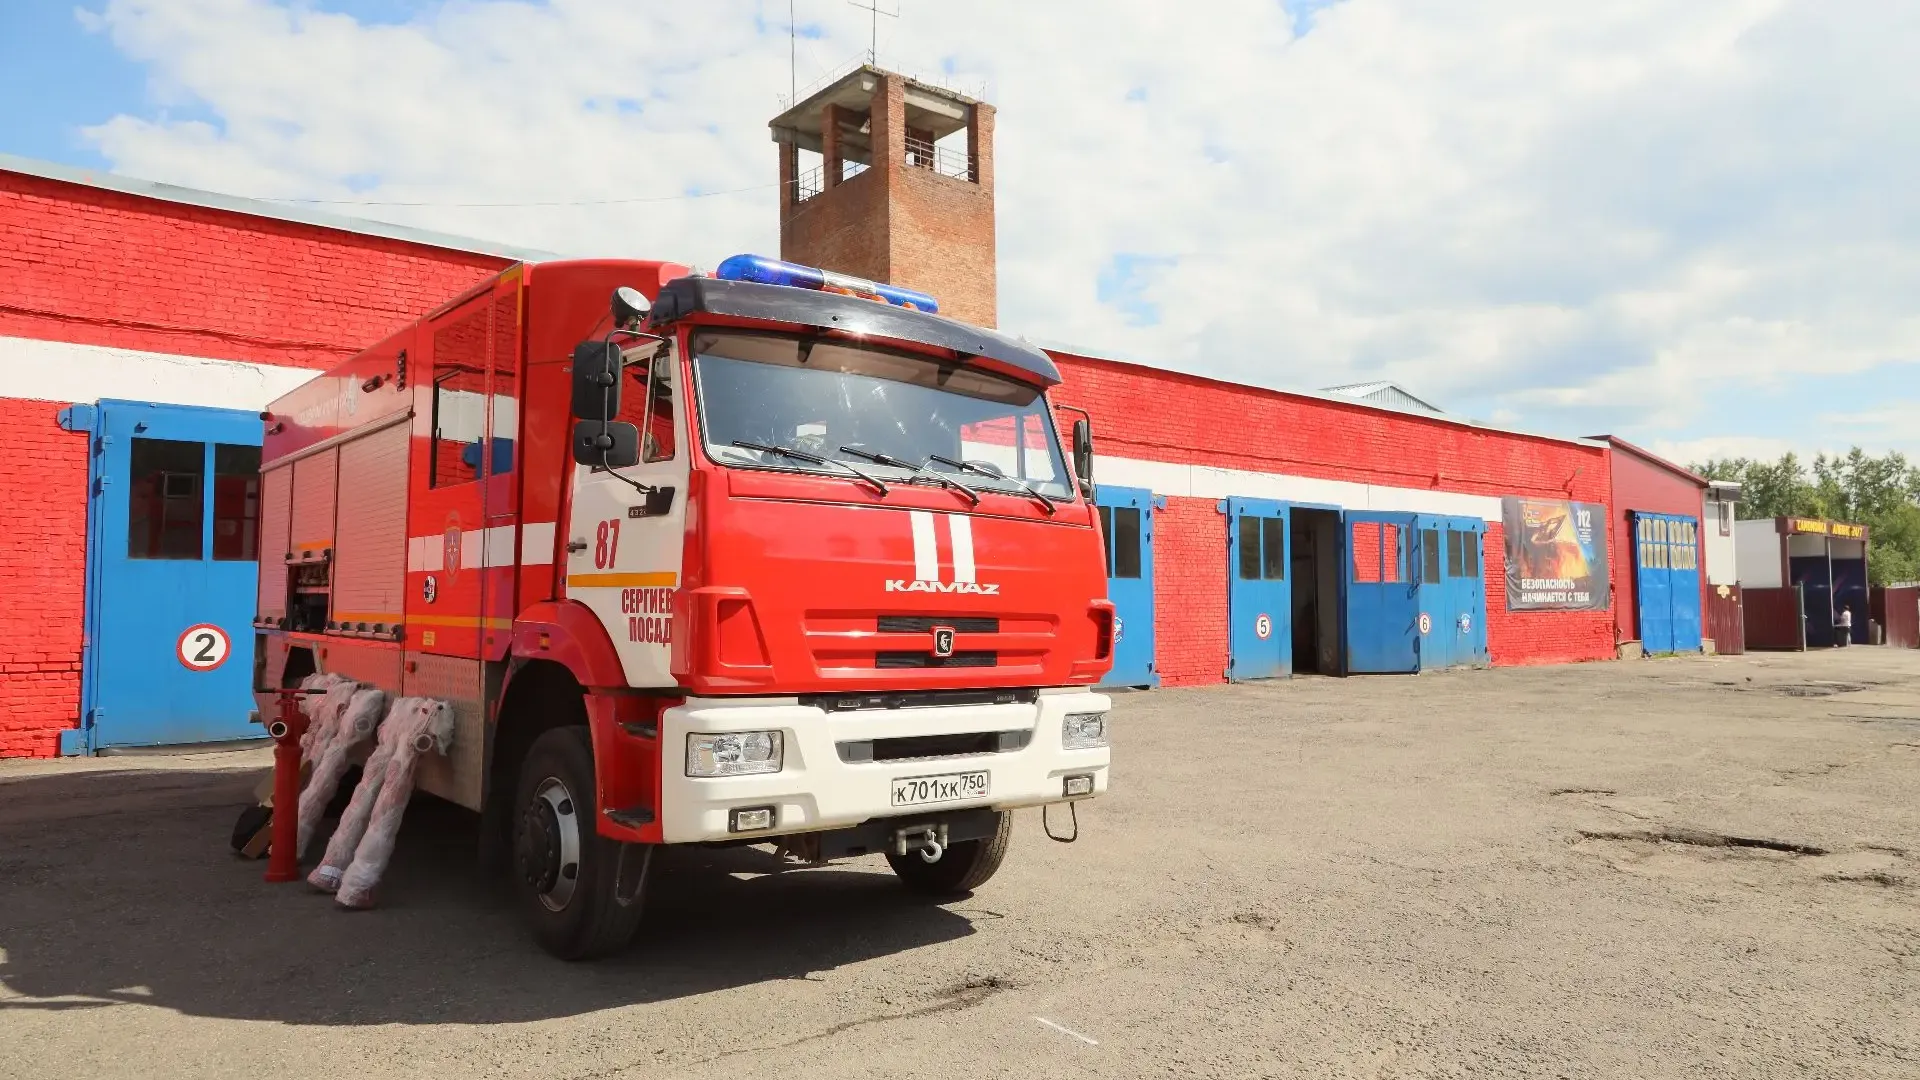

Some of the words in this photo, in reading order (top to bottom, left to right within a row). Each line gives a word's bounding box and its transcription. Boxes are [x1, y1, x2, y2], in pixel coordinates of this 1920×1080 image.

[1577, 509, 1591, 528] 112
[594, 519, 621, 570] 87
[885, 579, 1000, 595] KAMAZ
[1521, 578, 1576, 590] БЕЗОПАСНОСТЬ
[621, 588, 674, 614] СЕРГИЕВ
[1521, 592, 1567, 603] НАЧИНАЕТСЯ
[1573, 591, 1590, 602] ТЕБЯ
[629, 616, 672, 647] ПОСАД
[1260, 619, 1267, 635] 5
[1422, 617, 1428, 631] 6
[193, 633, 216, 662] 2
[961, 774, 985, 791] 750
